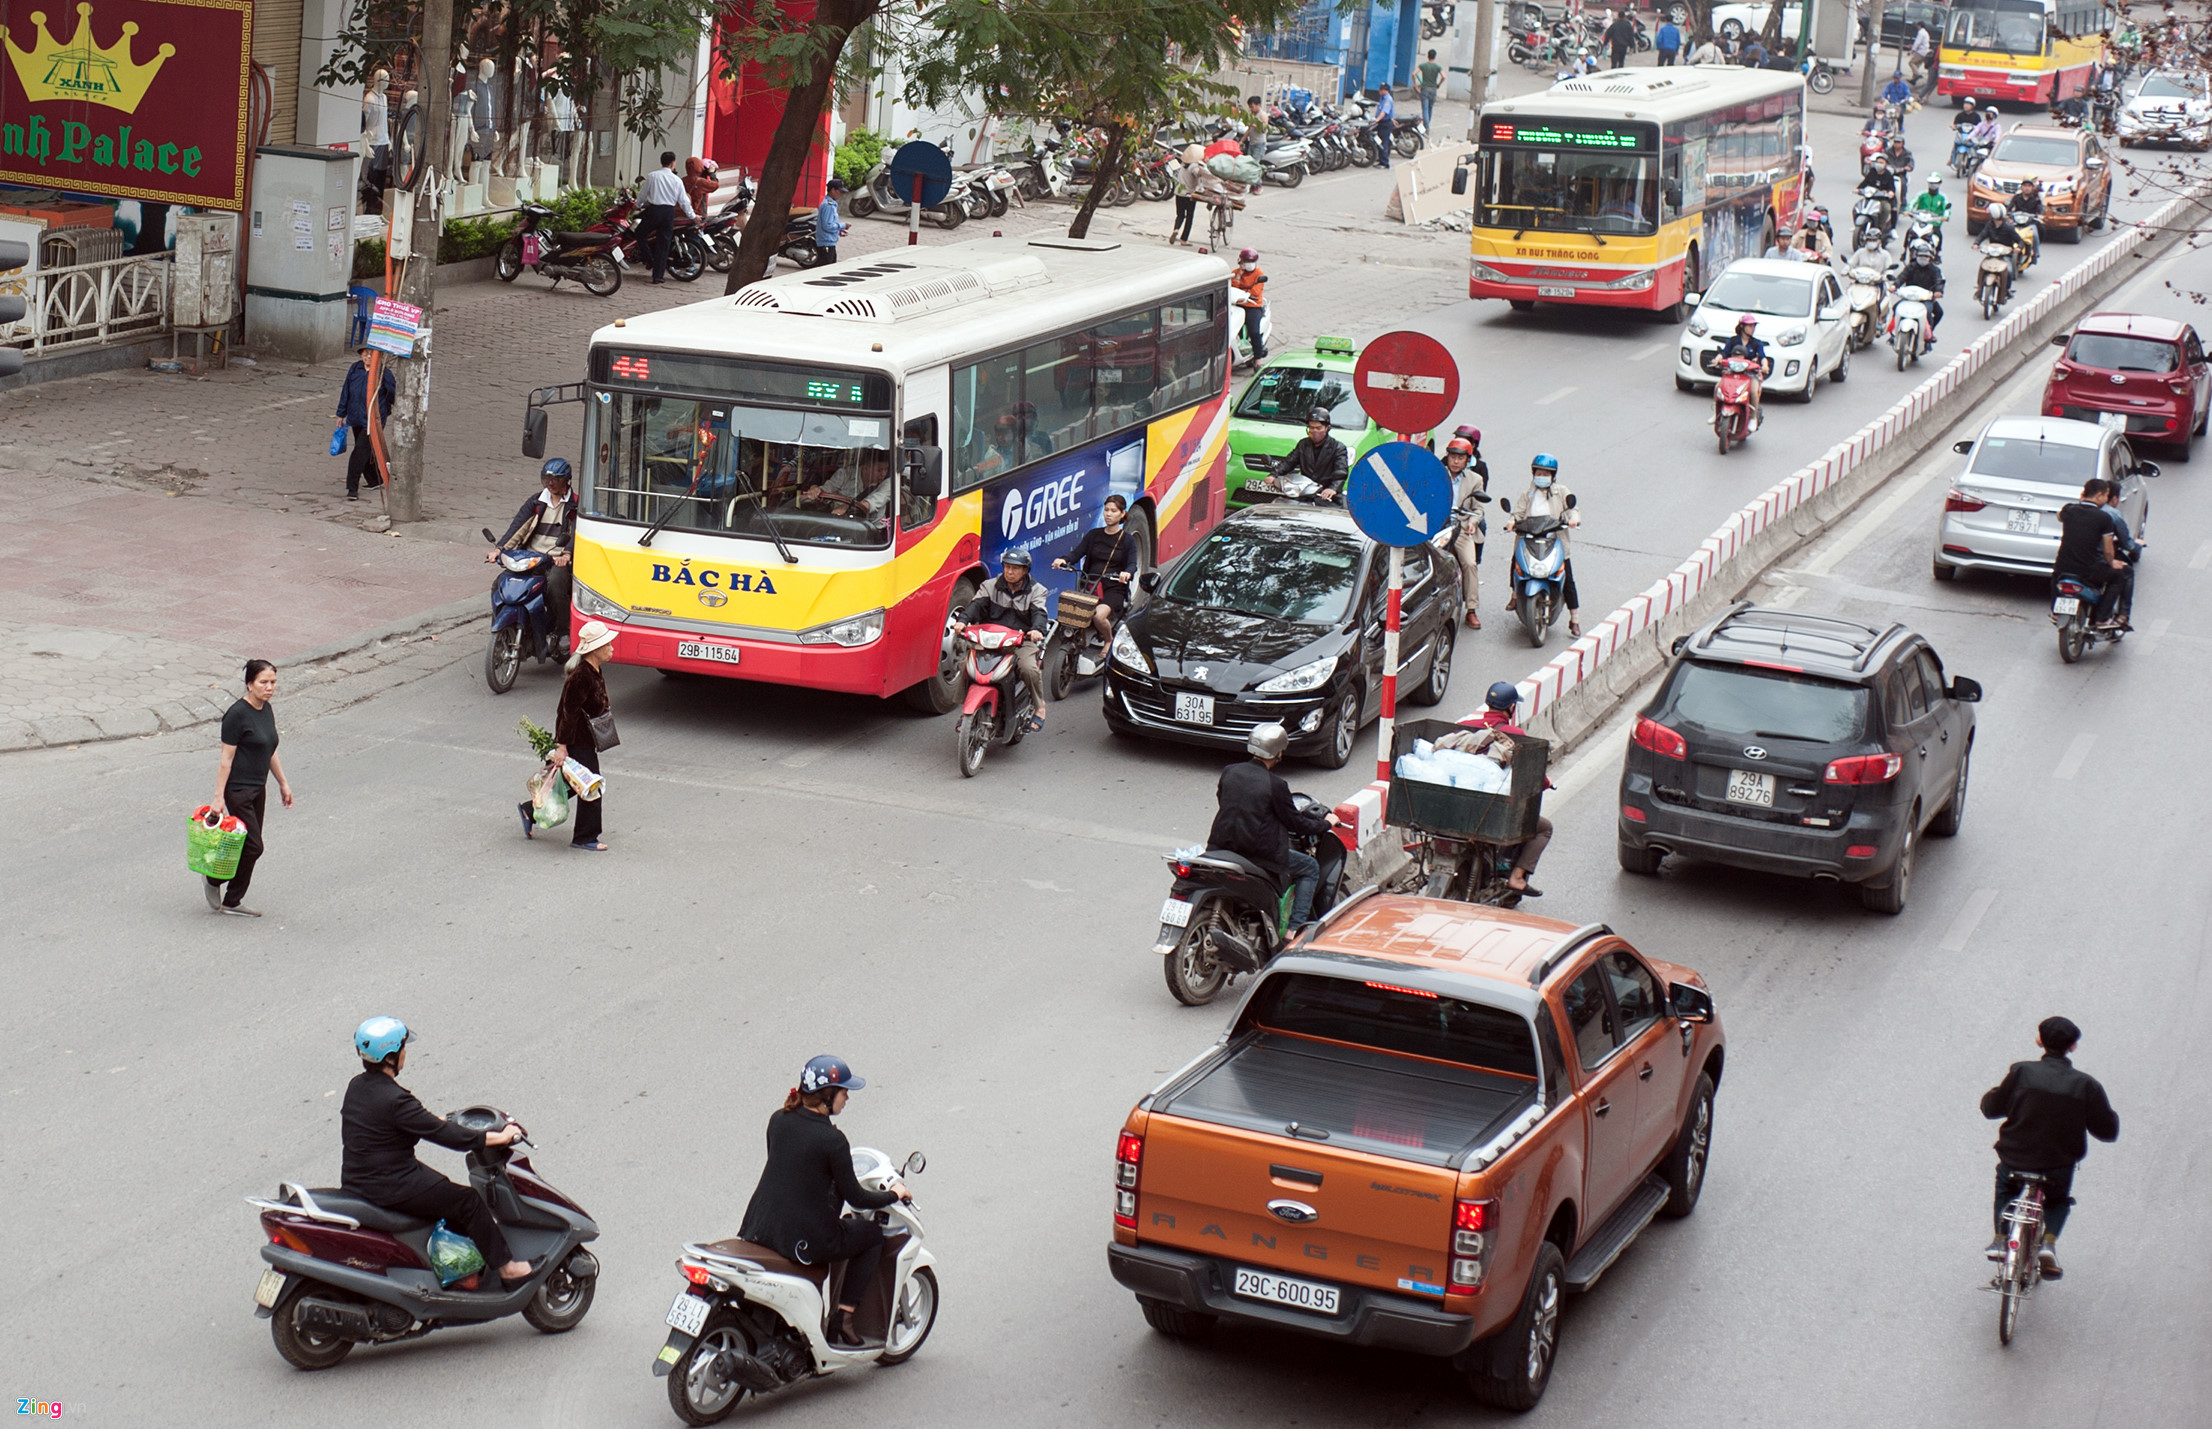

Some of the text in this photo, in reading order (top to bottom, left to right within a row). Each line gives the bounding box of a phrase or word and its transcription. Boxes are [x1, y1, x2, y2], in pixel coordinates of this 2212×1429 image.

[59, 78, 104, 91] XANH
[56, 120, 203, 178] Palace
[1529, 248, 1544, 257] BUS
[1577, 251, 1599, 260] LONG
[1025, 469, 1086, 530] GREE
[651, 558, 778, 594] BẮC HÀ
[680, 643, 737, 661] 29B-115.64
[1185, 695, 1204, 710] 30A
[1740, 771, 1763, 788] 29A
[1152, 1212, 1434, 1281] RANGER
[1238, 1272, 1337, 1310] 29C-600.95
